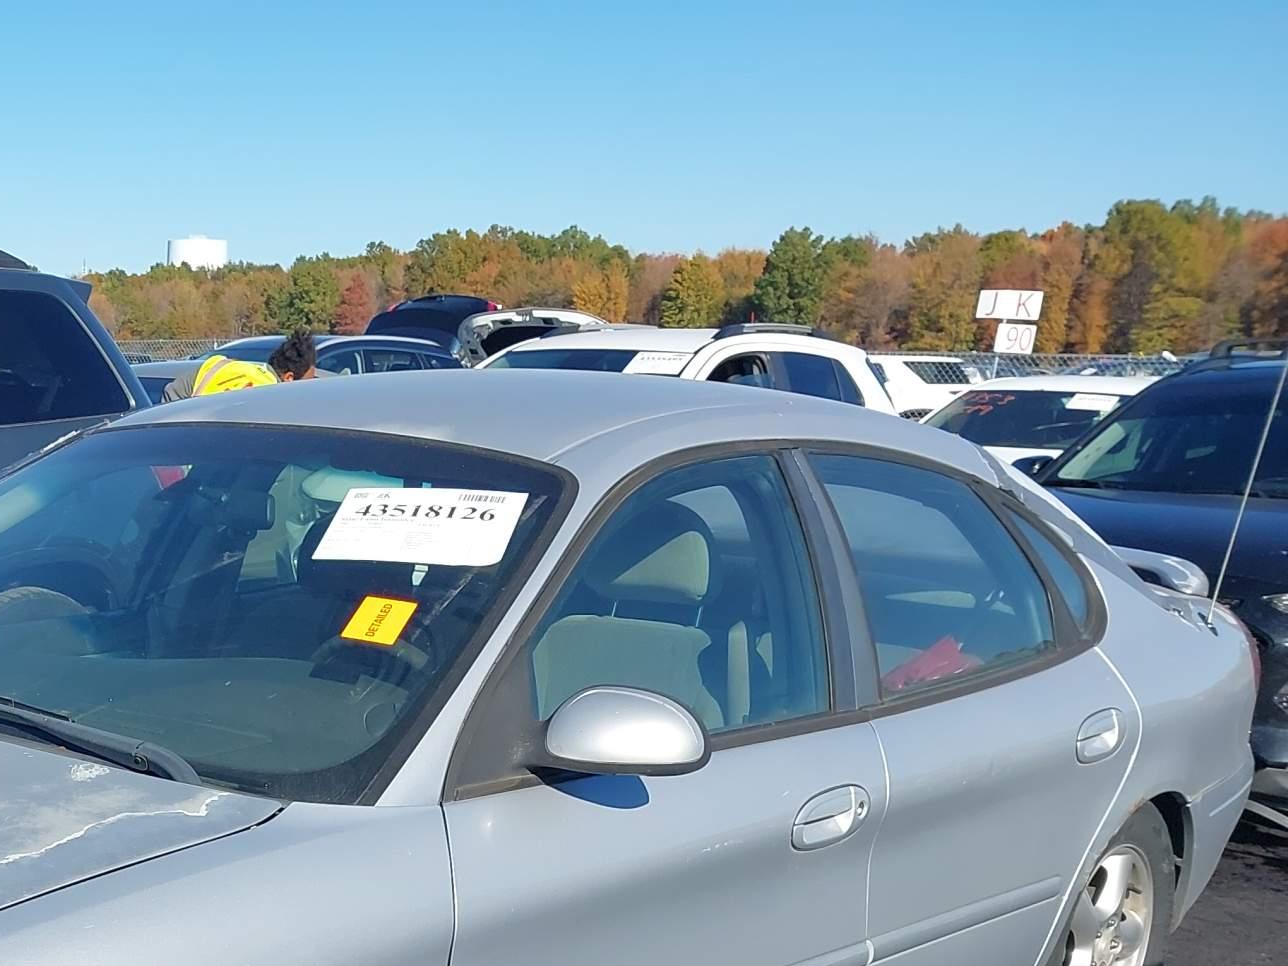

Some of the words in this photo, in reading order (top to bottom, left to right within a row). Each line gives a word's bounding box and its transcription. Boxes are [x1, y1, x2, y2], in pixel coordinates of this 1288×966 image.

[984, 292, 999, 316] J
[1015, 293, 1034, 317] K
[1005, 327, 1032, 351] 90
[355, 503, 496, 522] 43518126
[364, 603, 393, 638] DETAILED
